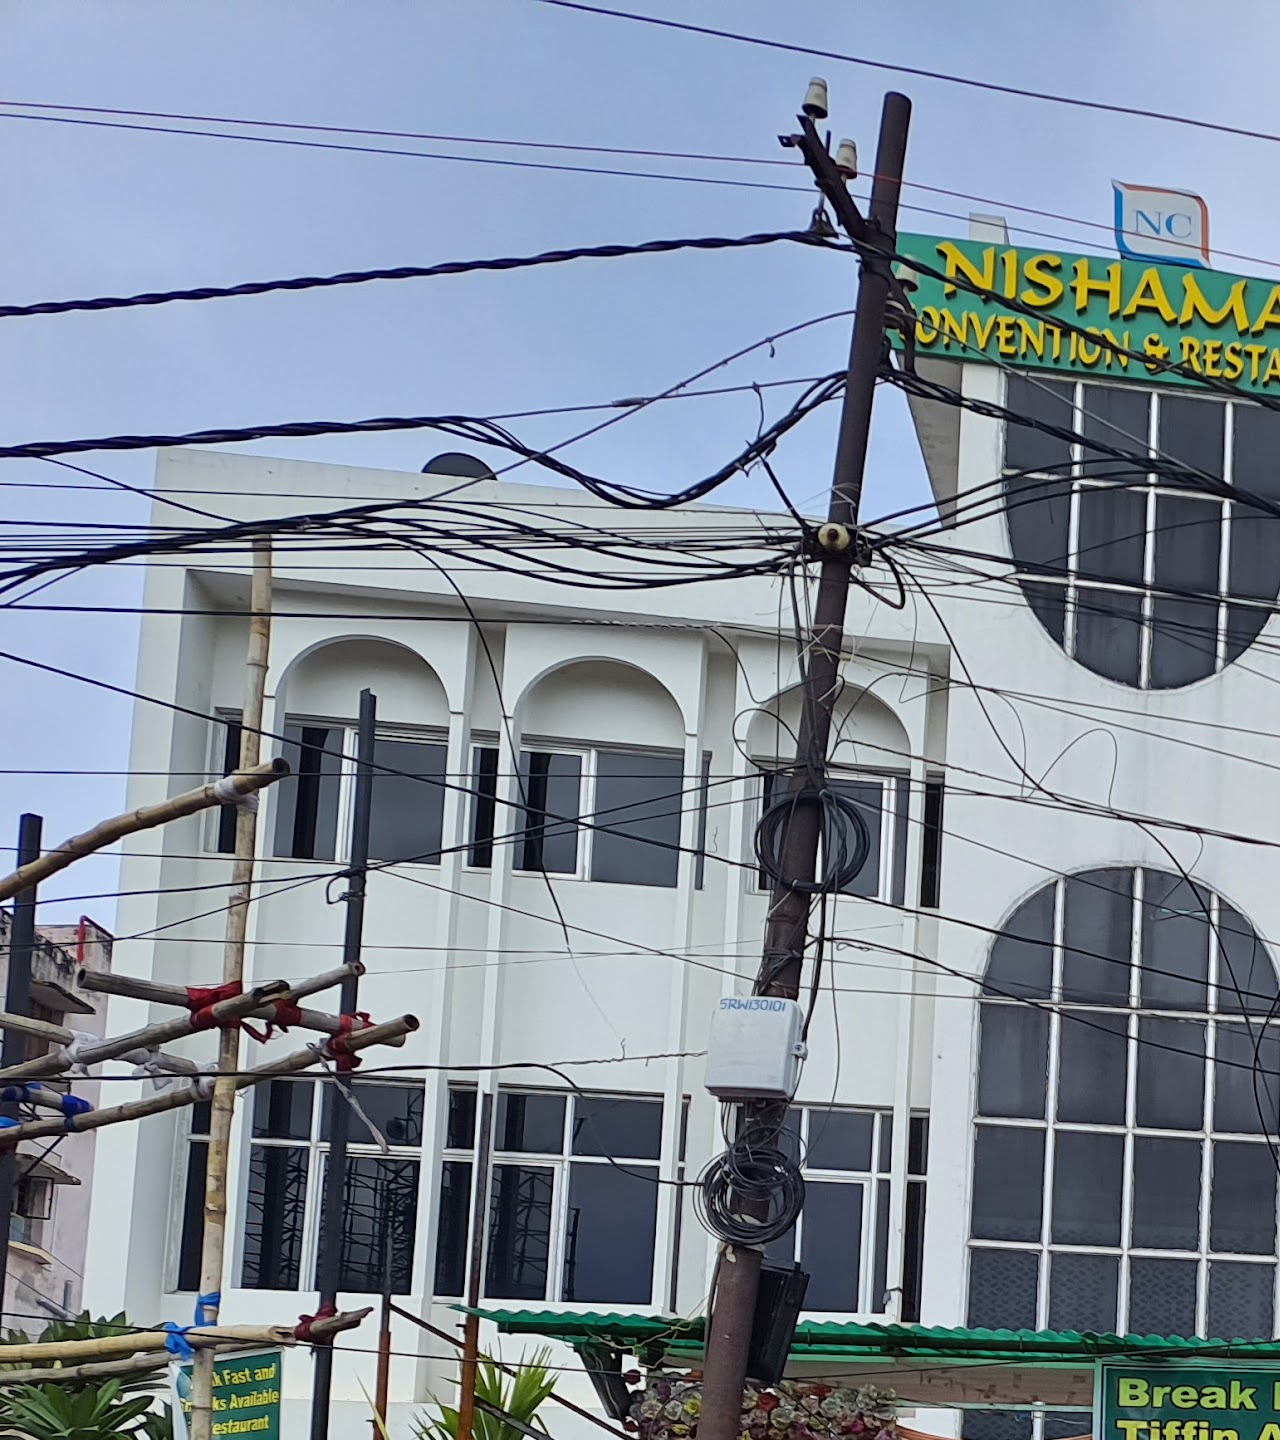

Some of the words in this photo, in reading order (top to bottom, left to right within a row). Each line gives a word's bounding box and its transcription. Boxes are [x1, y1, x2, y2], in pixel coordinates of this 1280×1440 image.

[1134, 209, 1192, 239] NC
[899, 304, 1130, 371] ONVENTION
[1143, 333, 1169, 373] &
[223, 1368, 252, 1385] Fast
[254, 1363, 276, 1380] and
[230, 1388, 279, 1410] Available
[1117, 1378, 1257, 1411] Break
[212, 1415, 269, 1435] estaurant
